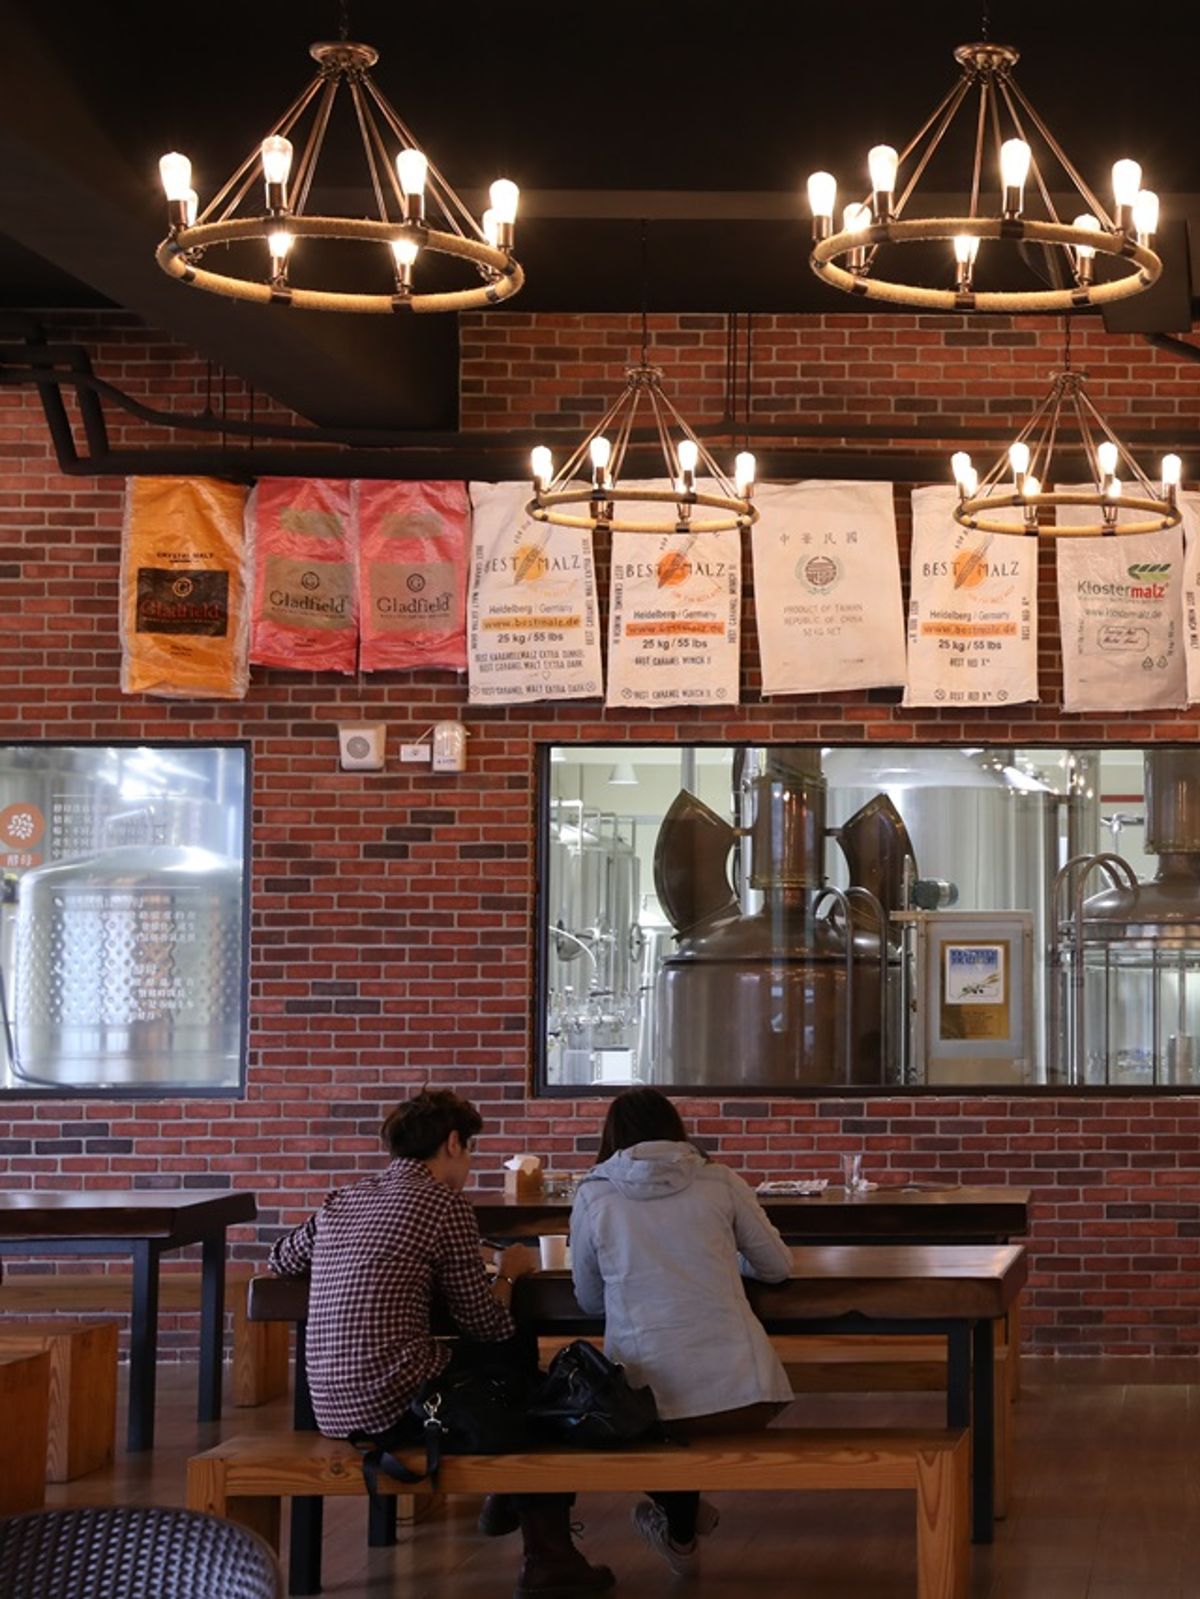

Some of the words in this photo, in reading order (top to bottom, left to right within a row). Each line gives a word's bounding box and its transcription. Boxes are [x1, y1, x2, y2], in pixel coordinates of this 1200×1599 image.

[270, 590, 345, 613] Gladfield
[376, 594, 450, 612] Gladfield
[634, 610, 676, 620] Heidelberg
[930, 610, 972, 622] Heidelberg
[498, 633, 510, 643] 25
[512, 633, 526, 645] kg
[534, 632, 546, 642] 55
[548, 632, 564, 641] lbs
[642, 639, 654, 649] 25
[658, 640, 670, 651] kg
[678, 638, 690, 648] 55
[692, 638, 708, 648] lbs
[938, 639, 950, 649] 25
[952, 640, 965, 652] kg
[973, 640, 985, 650] 55
[987, 640, 1002, 650] lbs
